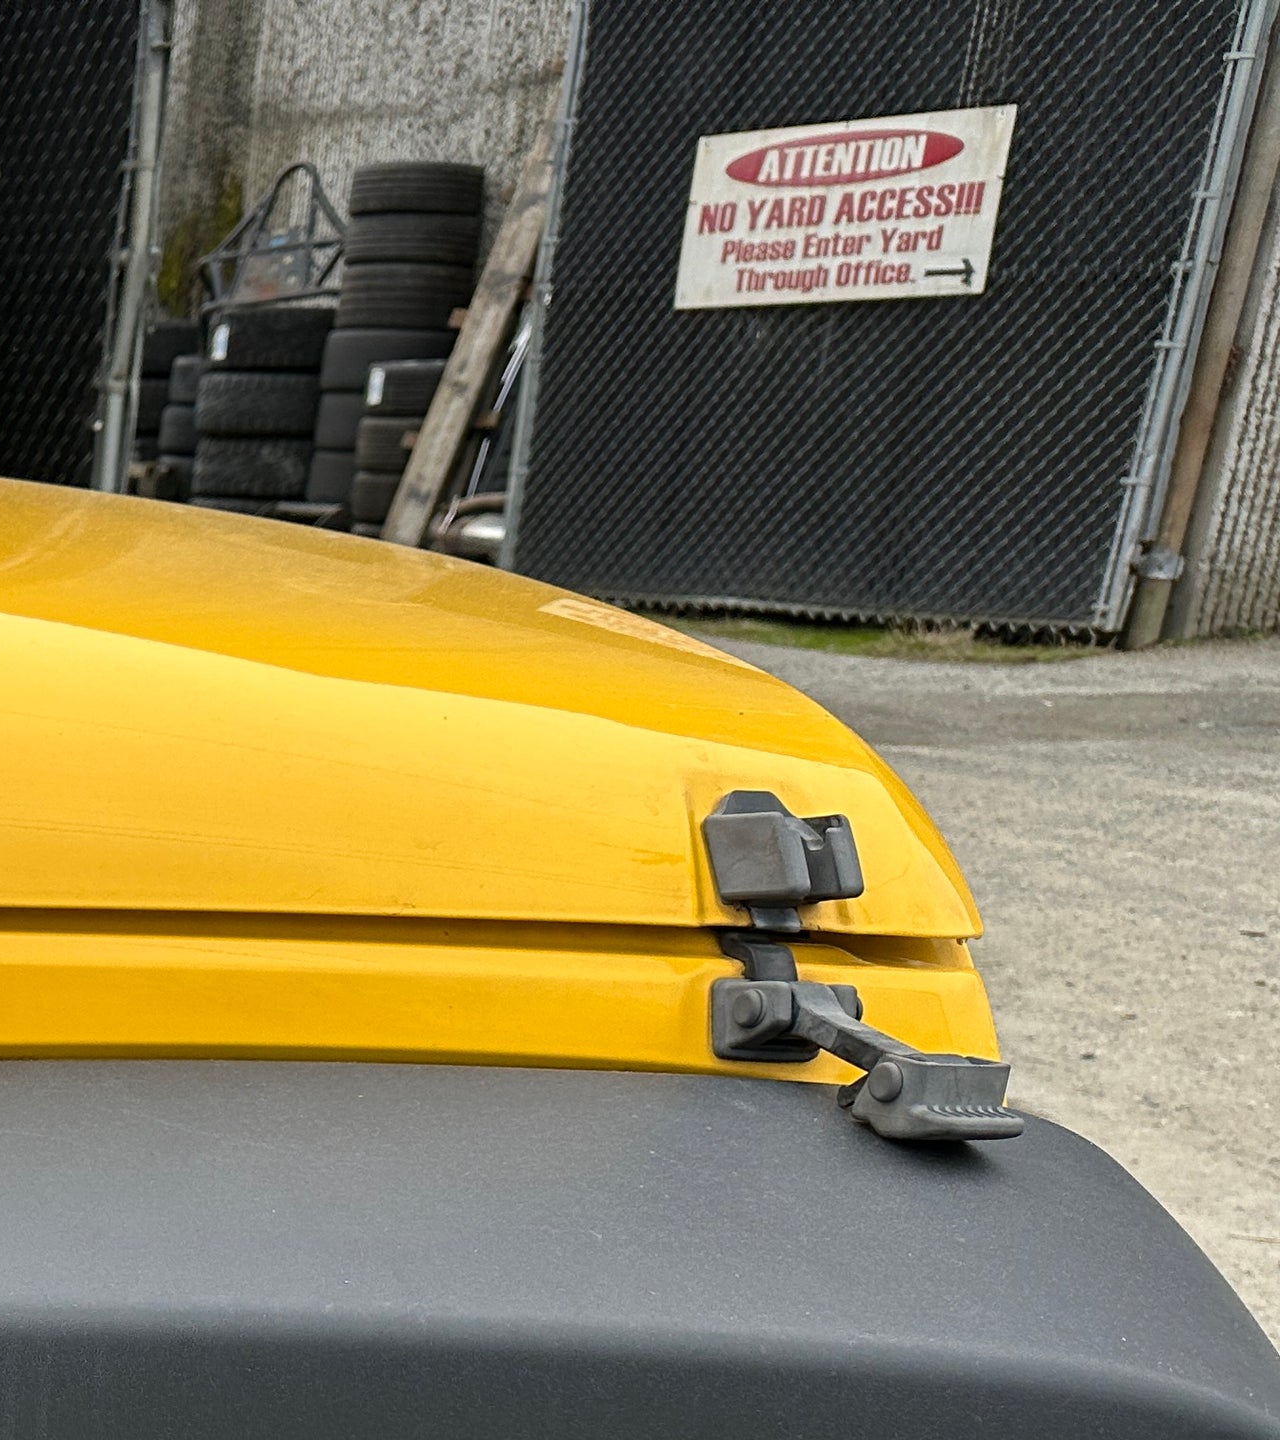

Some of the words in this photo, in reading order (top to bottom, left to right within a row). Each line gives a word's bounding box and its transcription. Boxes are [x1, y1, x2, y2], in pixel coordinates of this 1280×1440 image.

[757, 135, 928, 182] ATTENTION
[698, 203, 737, 235] NO
[747, 195, 825, 231] YARD
[834, 182, 986, 225] ACCESS!!!
[720, 237, 794, 264] Please
[801, 232, 871, 260] Enter
[880, 226, 944, 255] Yard
[735, 263, 828, 294] Through
